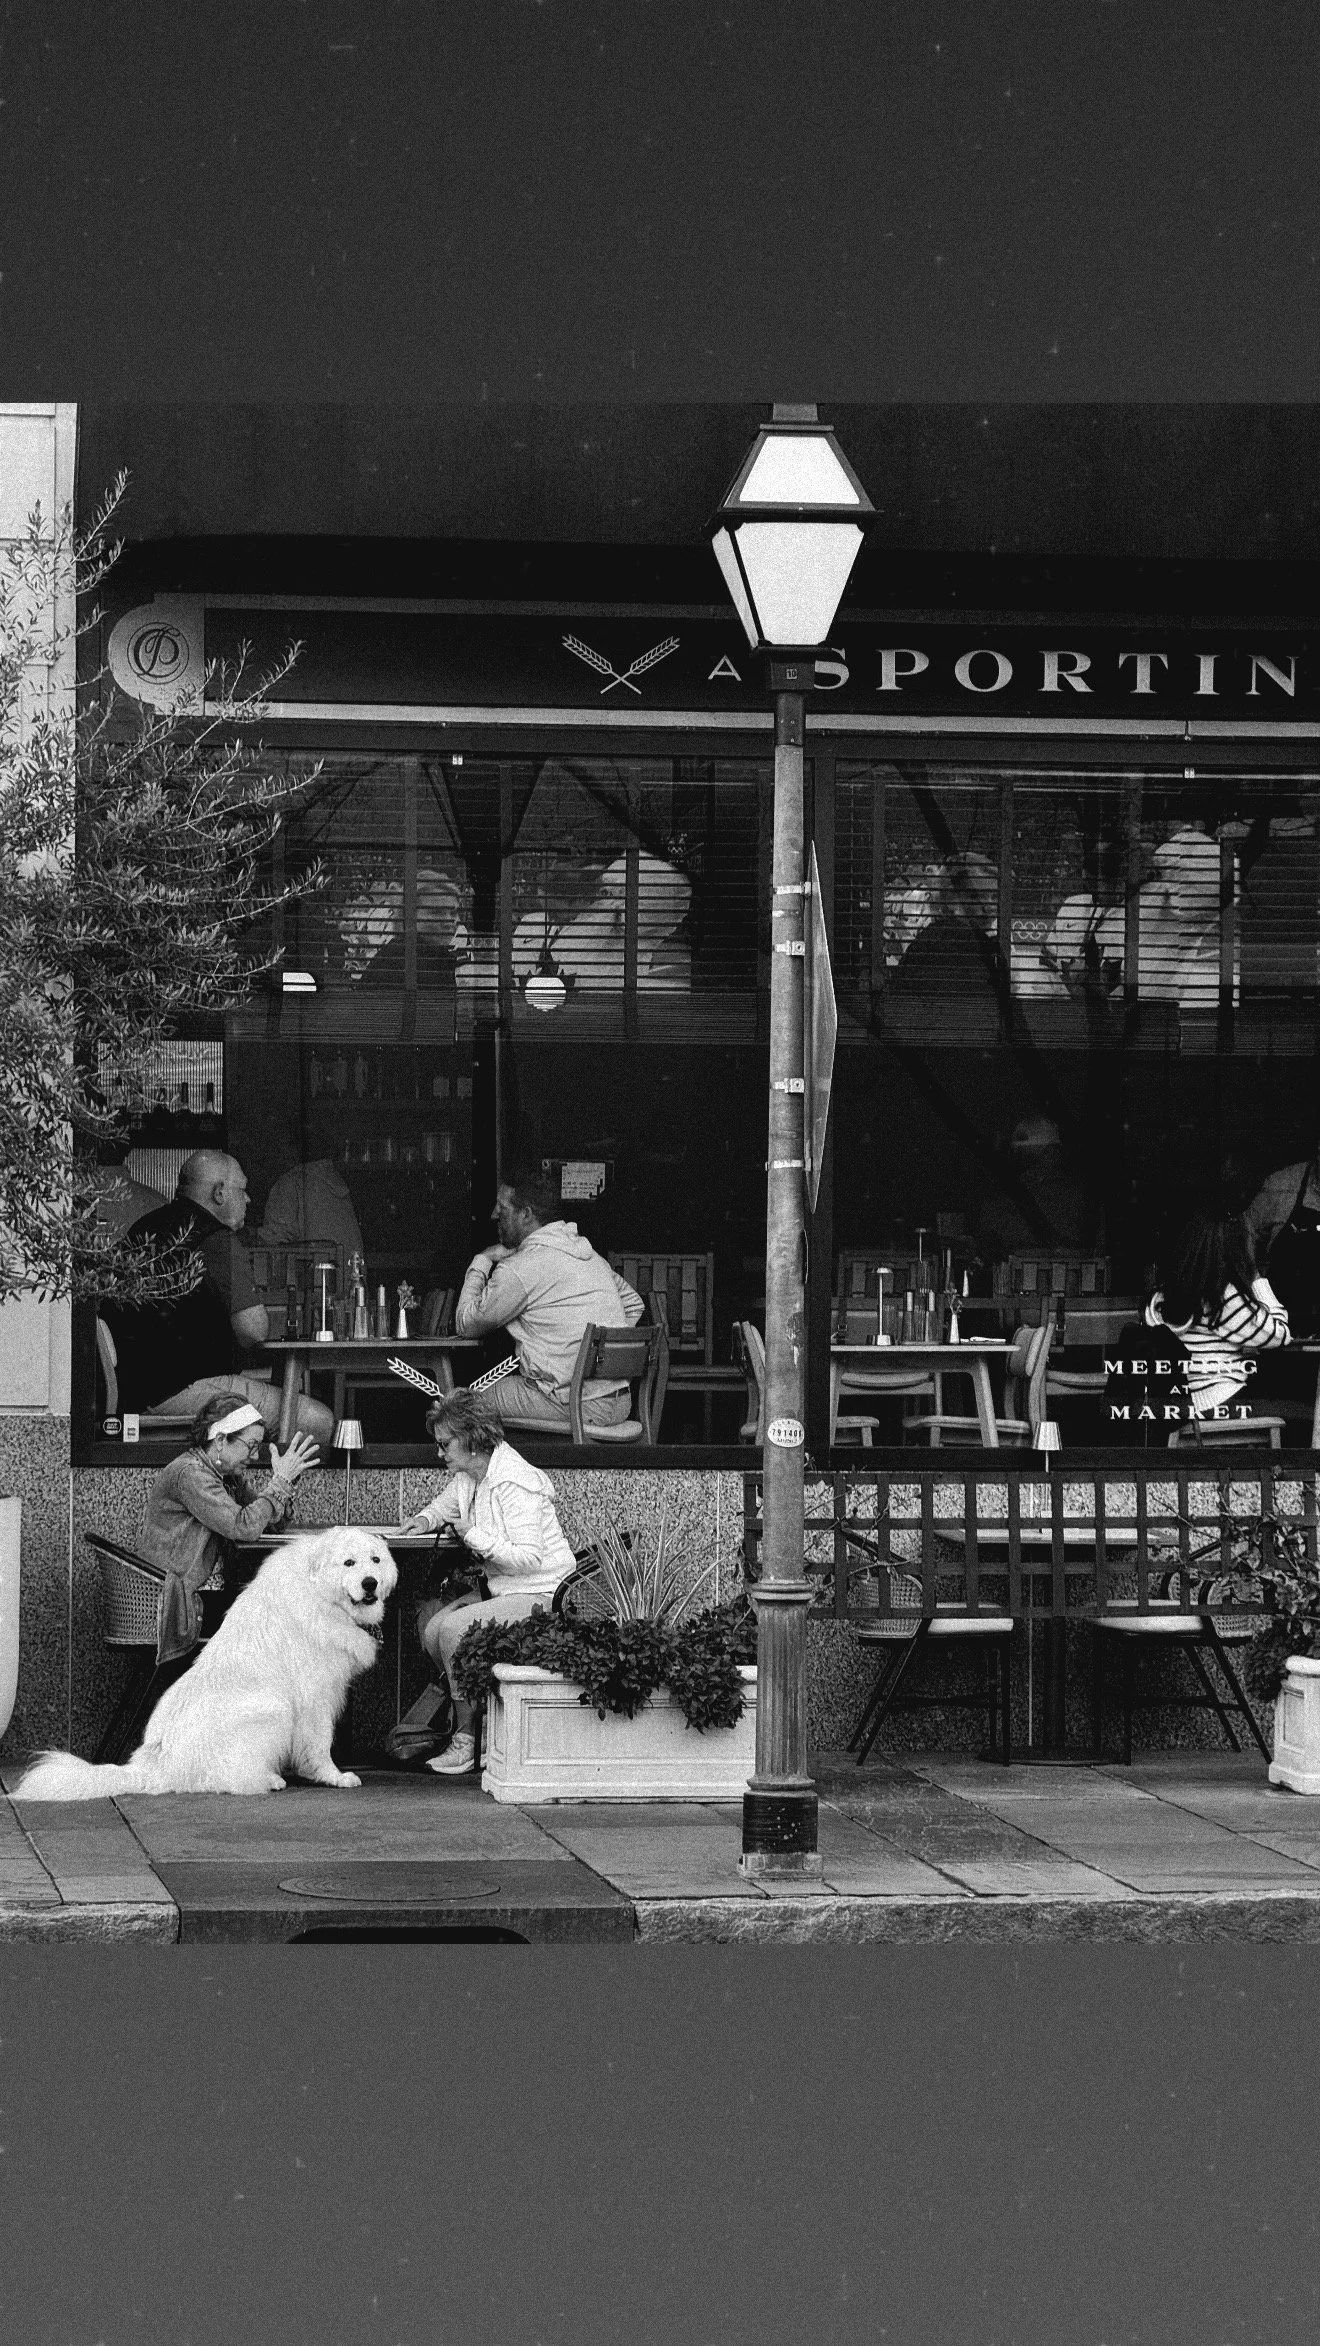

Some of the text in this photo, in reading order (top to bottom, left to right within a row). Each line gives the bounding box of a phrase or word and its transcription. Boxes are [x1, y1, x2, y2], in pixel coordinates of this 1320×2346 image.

[707, 654, 742, 681] A
[1170, 1385, 1192, 1395] AT
[1109, 1404, 1253, 1420] MARKET
